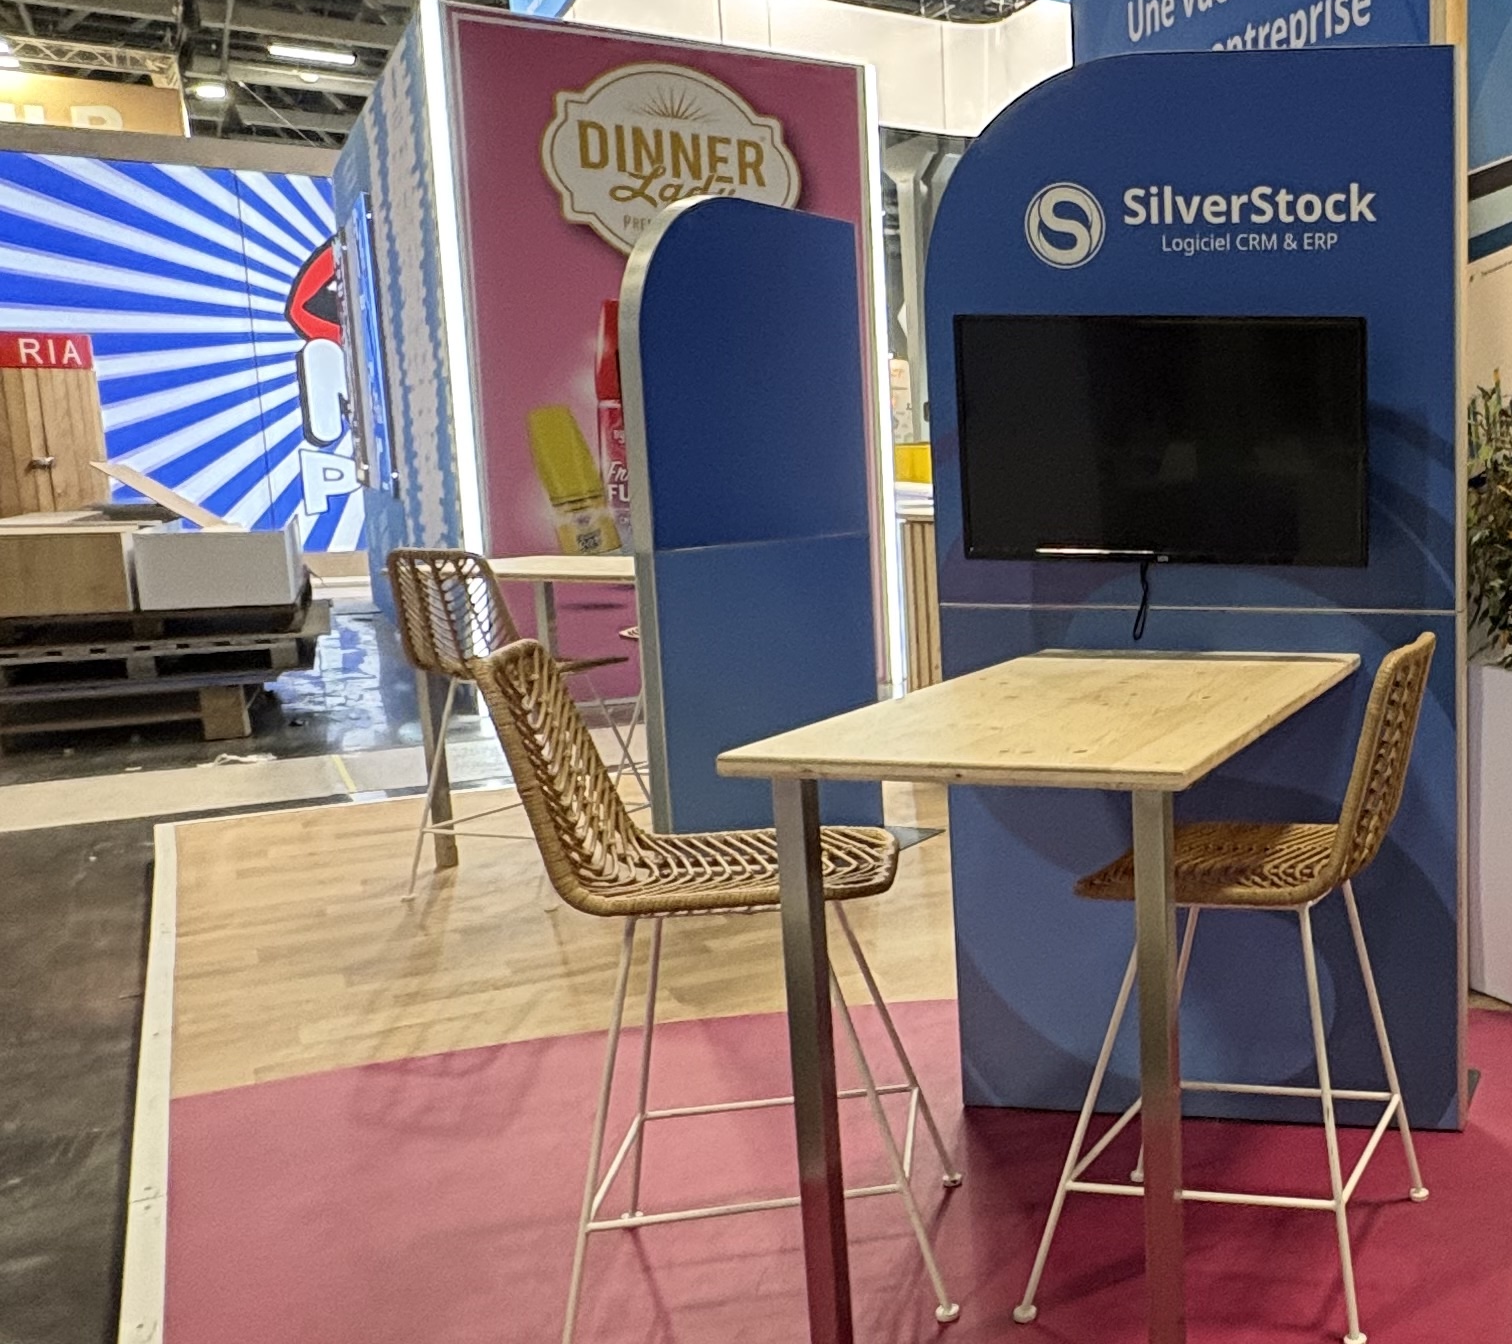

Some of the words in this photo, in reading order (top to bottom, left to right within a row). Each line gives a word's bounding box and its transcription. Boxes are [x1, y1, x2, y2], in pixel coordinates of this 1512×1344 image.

[576, 119, 766, 188] DINNER
[608, 164, 736, 208] Lad
[1122, 182, 1377, 226] SilverStock
[1161, 232, 1231, 257] Logiciel
[1235, 232, 1278, 251] CRM
[1282, 232, 1298, 251] &
[1302, 232, 1339, 251] ERP
